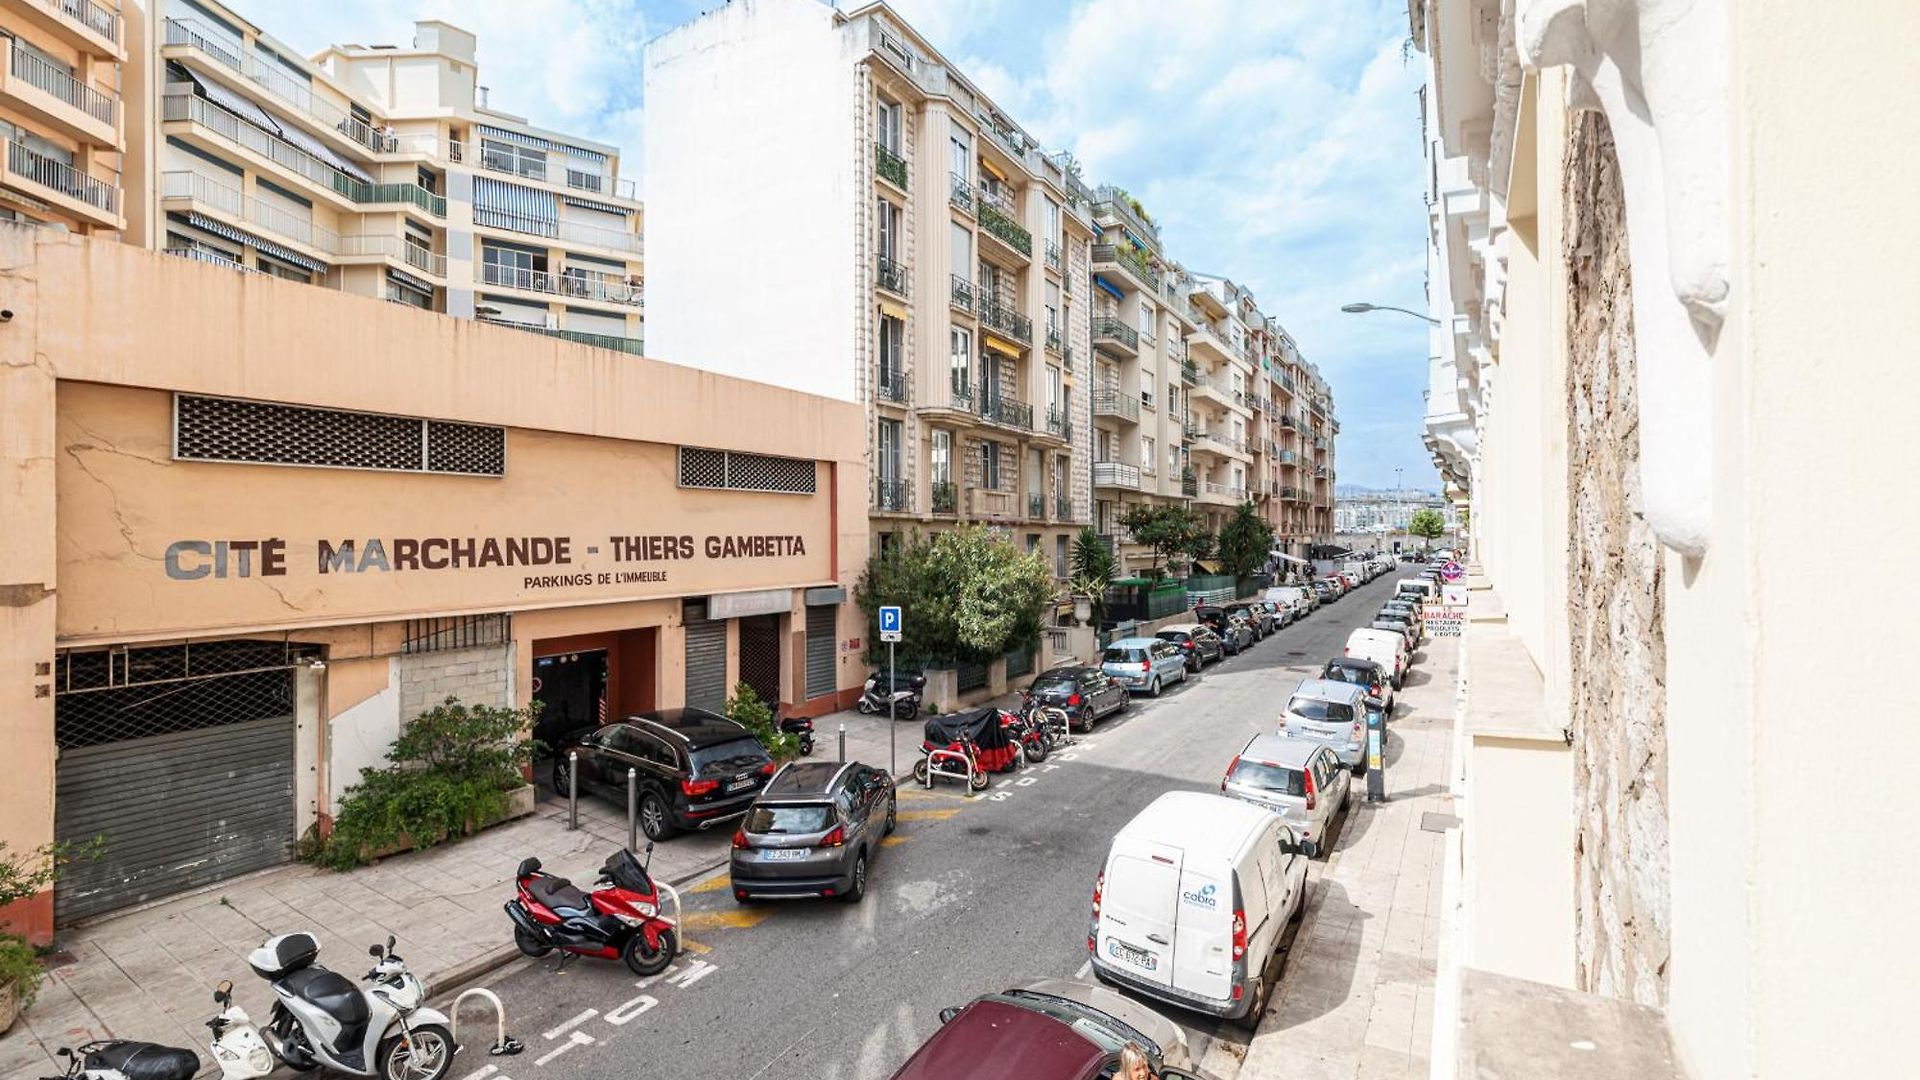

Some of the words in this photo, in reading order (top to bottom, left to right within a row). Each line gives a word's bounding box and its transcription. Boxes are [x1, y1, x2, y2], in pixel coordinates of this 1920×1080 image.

[165, 537, 286, 580] CITÉ
[318, 537, 571, 574] MARCHANDE
[610, 535, 695, 562] THIERS
[704, 535, 806, 559] GAMBETTA
[524, 574, 592, 589] PARKINGS
[598, 573, 611, 585] DE
[885, 612, 894, 628] P
